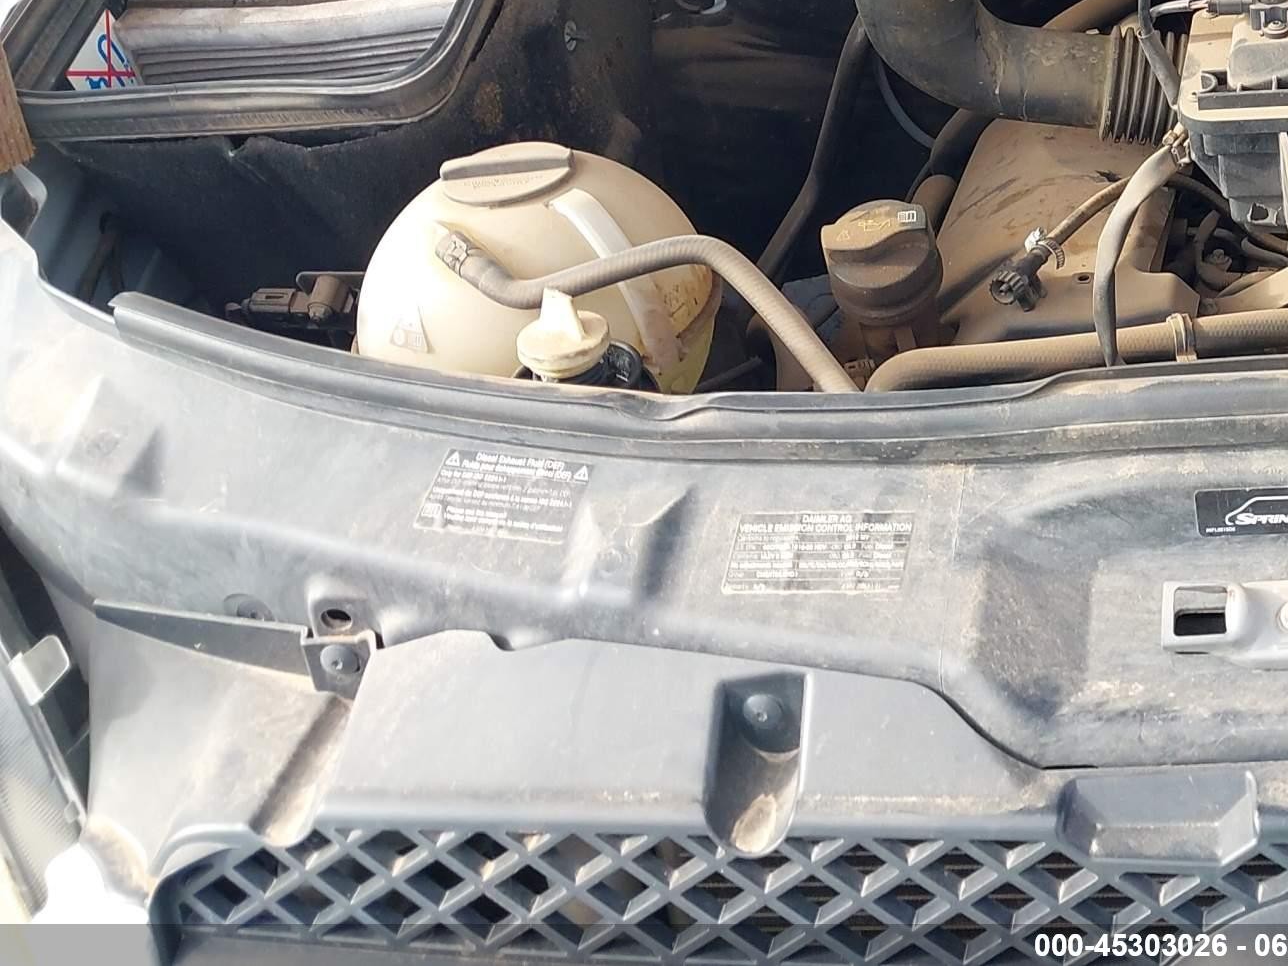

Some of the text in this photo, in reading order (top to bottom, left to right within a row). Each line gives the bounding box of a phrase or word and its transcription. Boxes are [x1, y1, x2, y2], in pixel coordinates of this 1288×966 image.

[801, 514, 852, 524] DAIMLER AG
[739, 523, 773, 533] VEHICLE
[814, 523, 854, 533] CONTROL
[854, 522, 912, 533] INFORMATION
